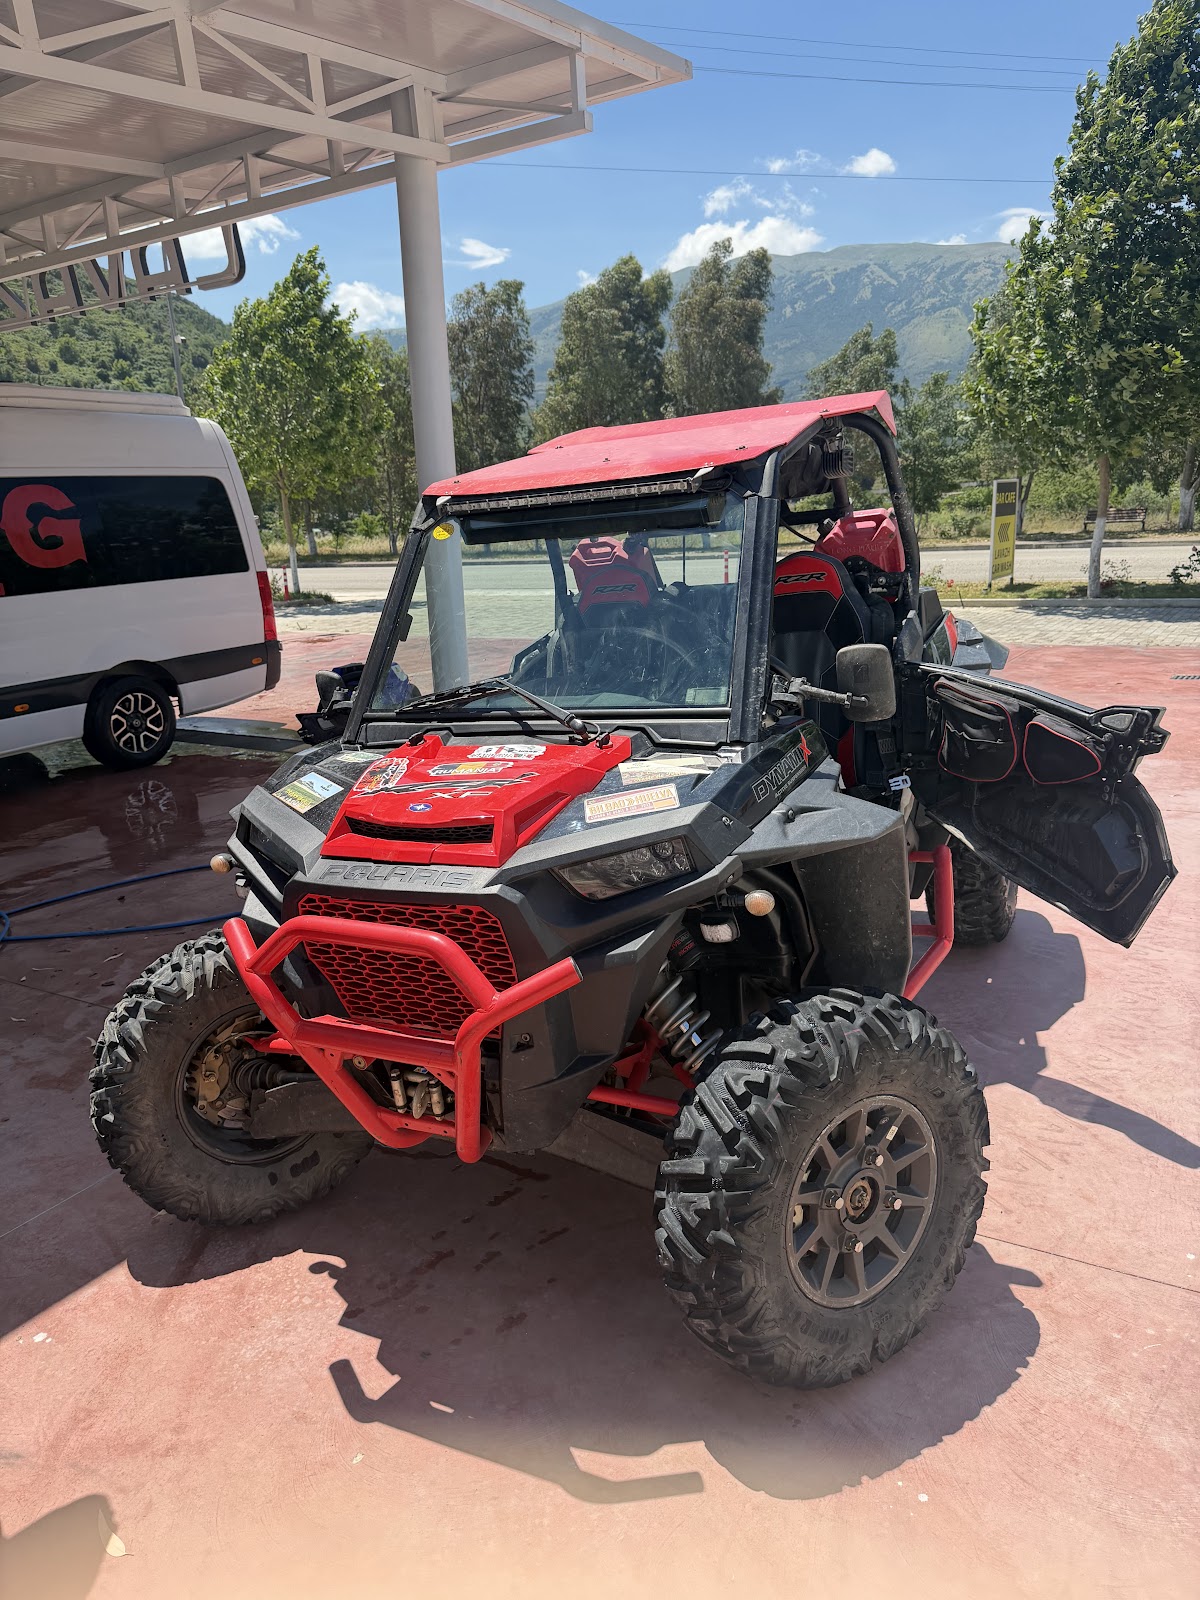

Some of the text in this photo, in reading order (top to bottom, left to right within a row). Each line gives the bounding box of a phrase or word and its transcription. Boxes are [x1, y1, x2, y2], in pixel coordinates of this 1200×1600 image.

[996, 492, 1005, 504] BAR
[992, 561, 1012, 574] CAR WASH
[775, 572, 827, 587] RZR
[592, 583, 638, 596] RZR
[434, 767, 496, 776] RUMANIA
[751, 729, 812, 803] DYNAMIX
[421, 788, 493, 800] XP
[588, 800, 626, 815] BILBAO
[635, 788, 674, 804] HUELVA
[319, 864, 474, 889] POLARIS
